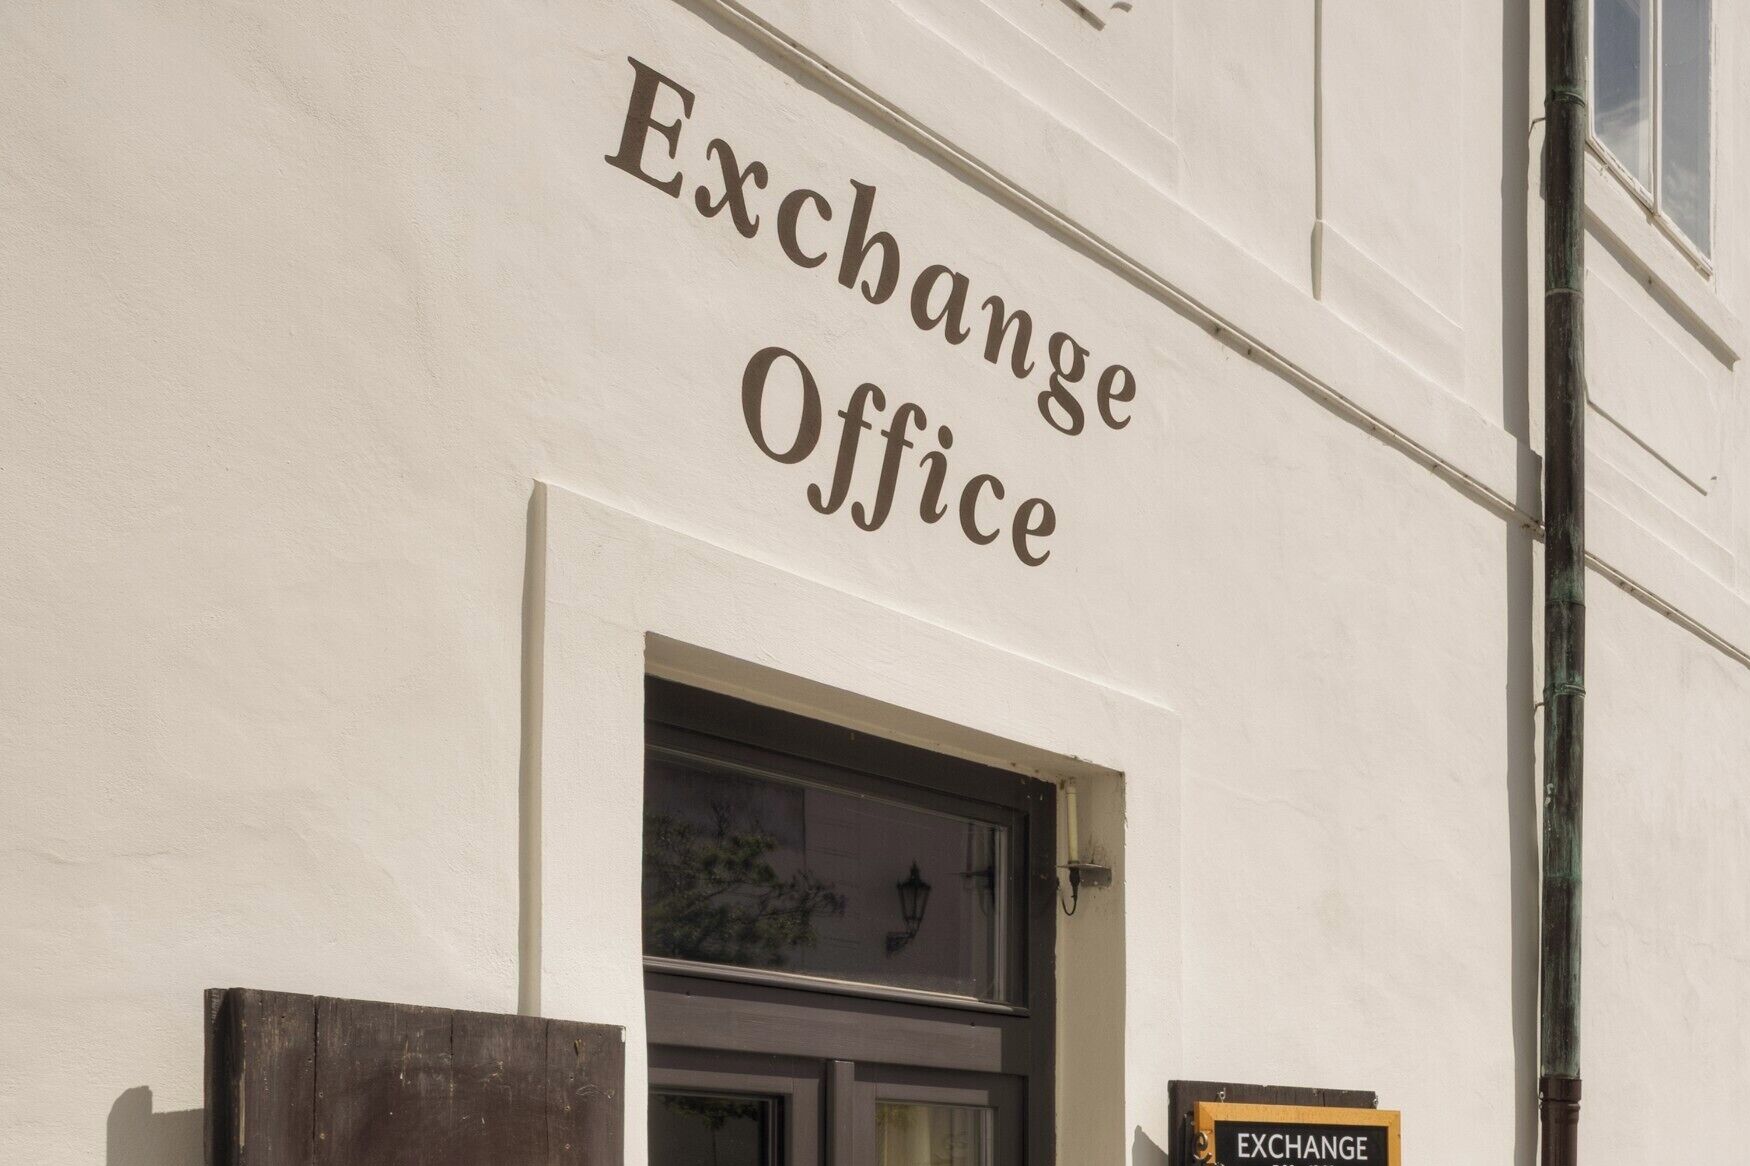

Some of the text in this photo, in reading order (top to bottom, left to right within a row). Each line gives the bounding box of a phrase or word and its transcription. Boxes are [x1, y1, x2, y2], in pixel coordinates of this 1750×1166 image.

[604, 56, 1137, 436] Exchange
[741, 346, 1057, 567] Office
[1237, 1133, 1368, 1160] EXCHANGE
